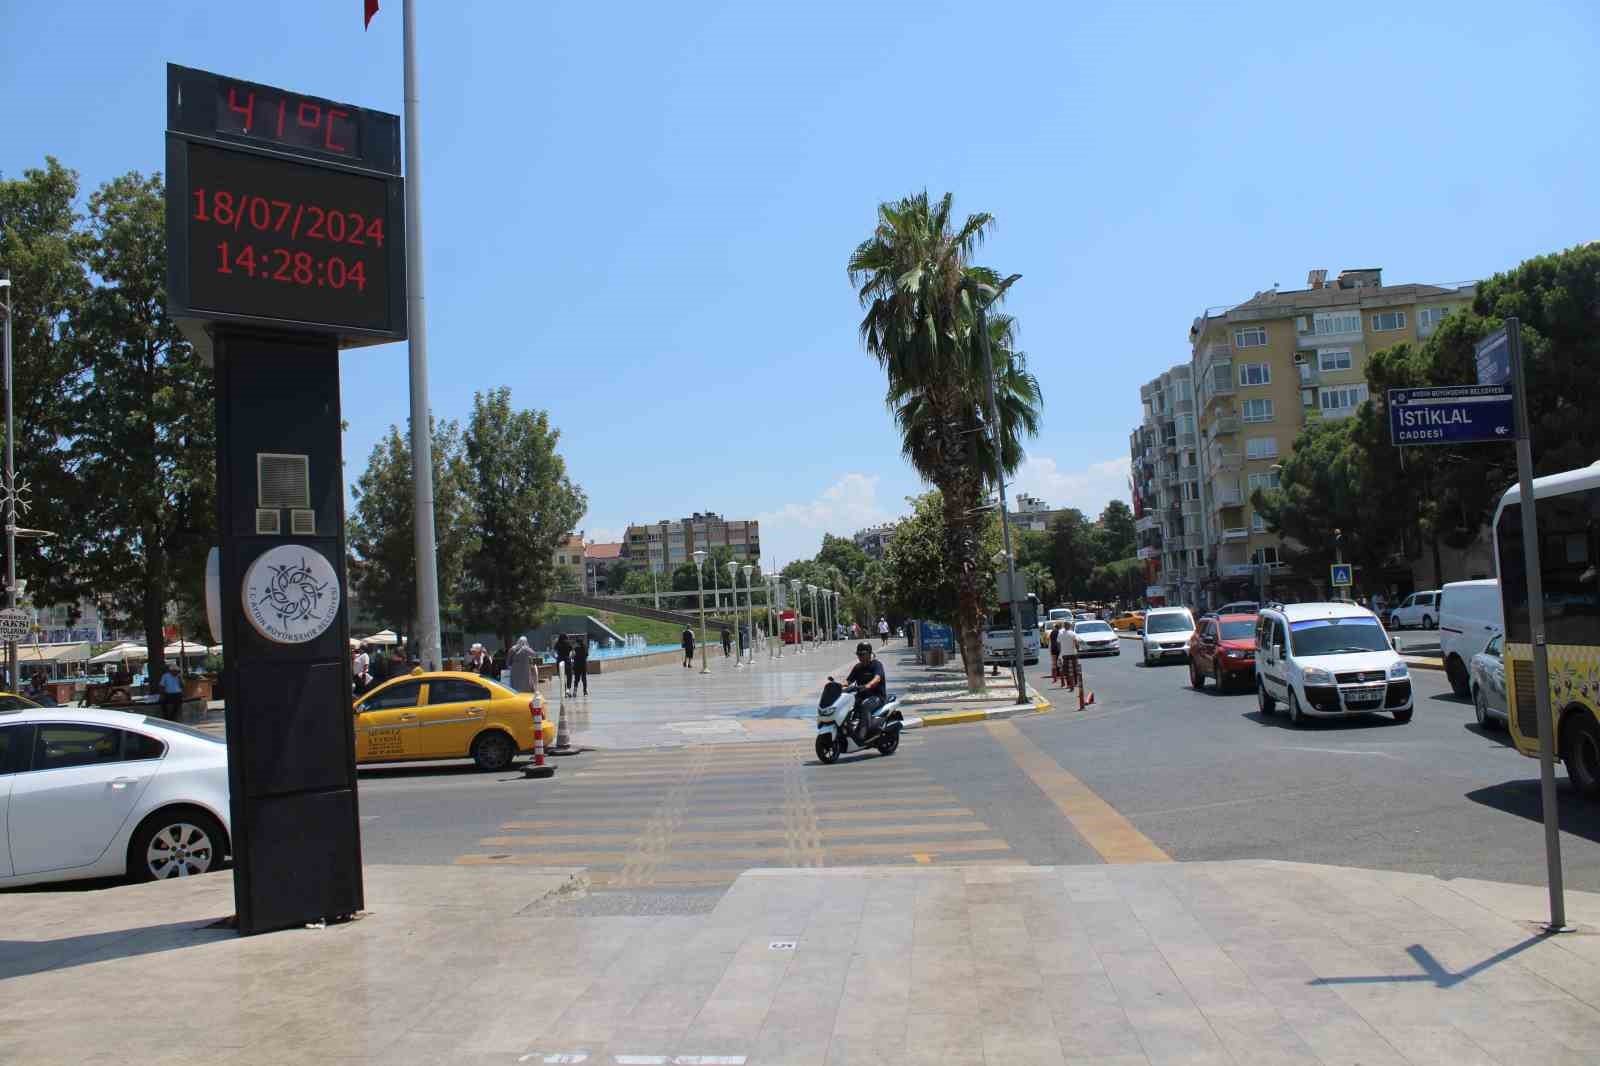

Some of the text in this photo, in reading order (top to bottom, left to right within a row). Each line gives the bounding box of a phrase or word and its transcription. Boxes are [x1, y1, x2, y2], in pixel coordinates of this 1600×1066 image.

[192, 187, 385, 247] 18/07/2024
[216, 239, 367, 293] 14:28:04
[1399, 407, 1473, 426] İSTİKLAL
[1400, 429, 1444, 440] CADDESİ
